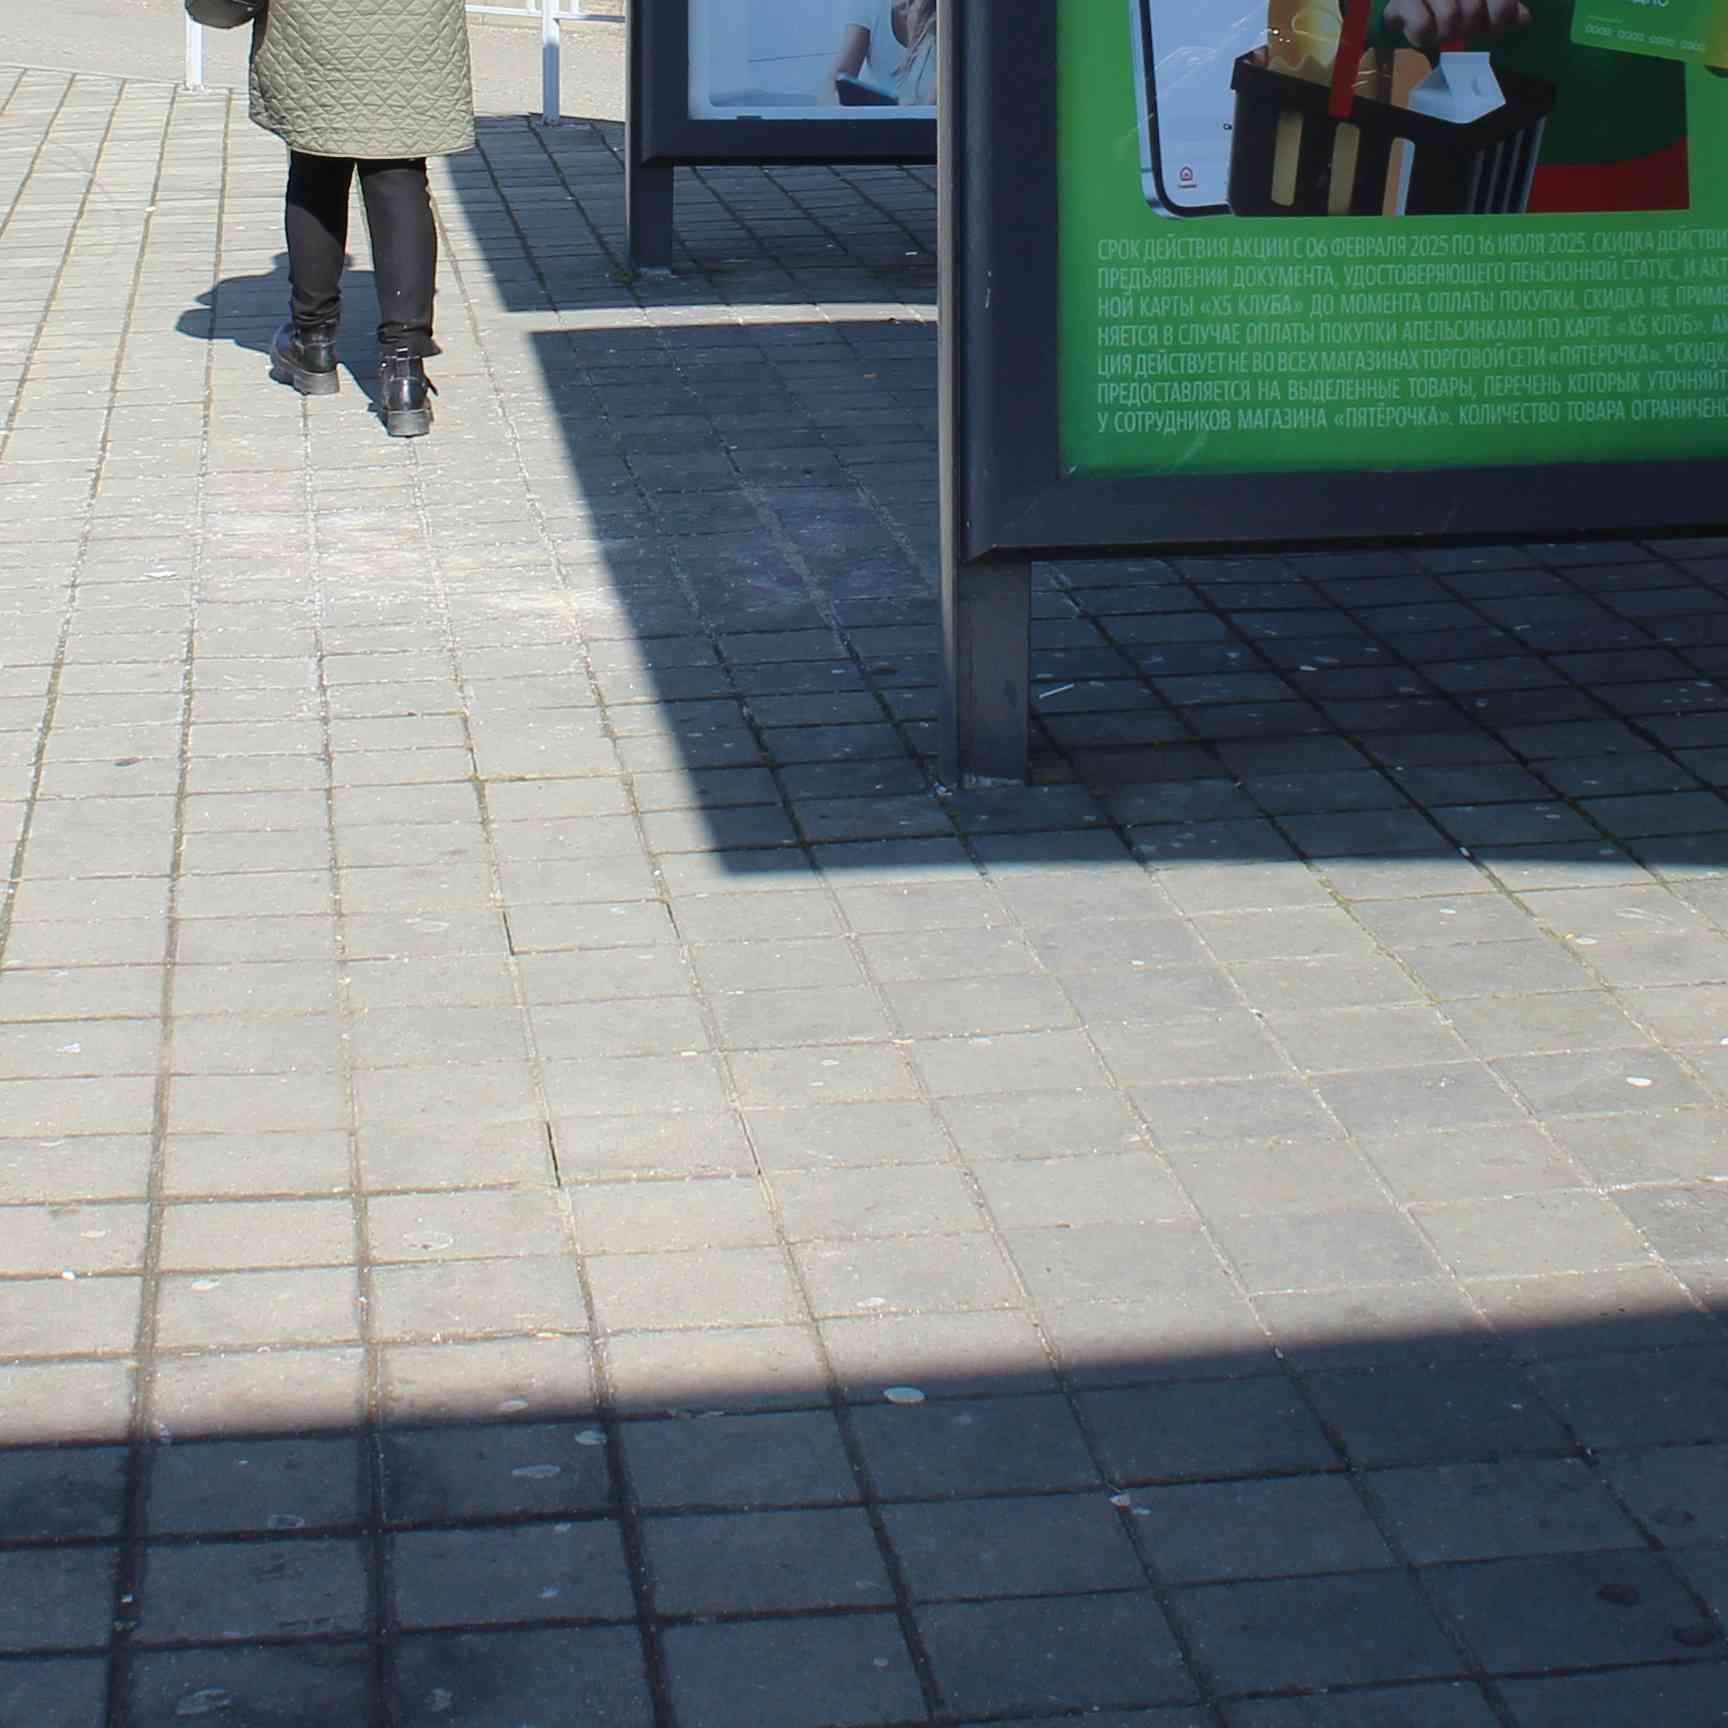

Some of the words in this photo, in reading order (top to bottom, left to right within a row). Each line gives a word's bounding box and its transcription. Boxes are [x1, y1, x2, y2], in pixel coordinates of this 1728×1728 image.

[1097, 238, 1141, 260] СРОК
[1142, 232, 1229, 263] ДЕЙСТВИЯ
[1232, 235, 1289, 262] АКЦИИ
[1331, 233, 1407, 256] ФЕВРАЛЯ
[1410, 233, 1449, 255] 2025
[1452, 232, 1473, 254] ПО
[1498, 231, 1545, 254] ИЮЛЯ
[1140, 295, 1194, 317] КАРТЫ
[1310, 293, 1334, 317] ДО
[1341, 291, 1421, 313] МОМЕНТА
[1427, 290, 1494, 311] ОПЛАТЫ
[1097, 380, 1251, 408] ПРЕДОСТАВЛЯЕТСЯ
[1258, 379, 1281, 400] НА
[1288, 377, 1400, 403] ВЫДЕЛЕННЫЕ
[1483, 373, 1561, 395] ПЕРЕЧЕНЬ
[1097, 411, 1110, 433] У
[1114, 408, 1232, 436] СОТРУДНИКОВ
[1237, 406, 1327, 429] МАГАЗИНА
[1564, 400, 1626, 421] ТОВАРА
